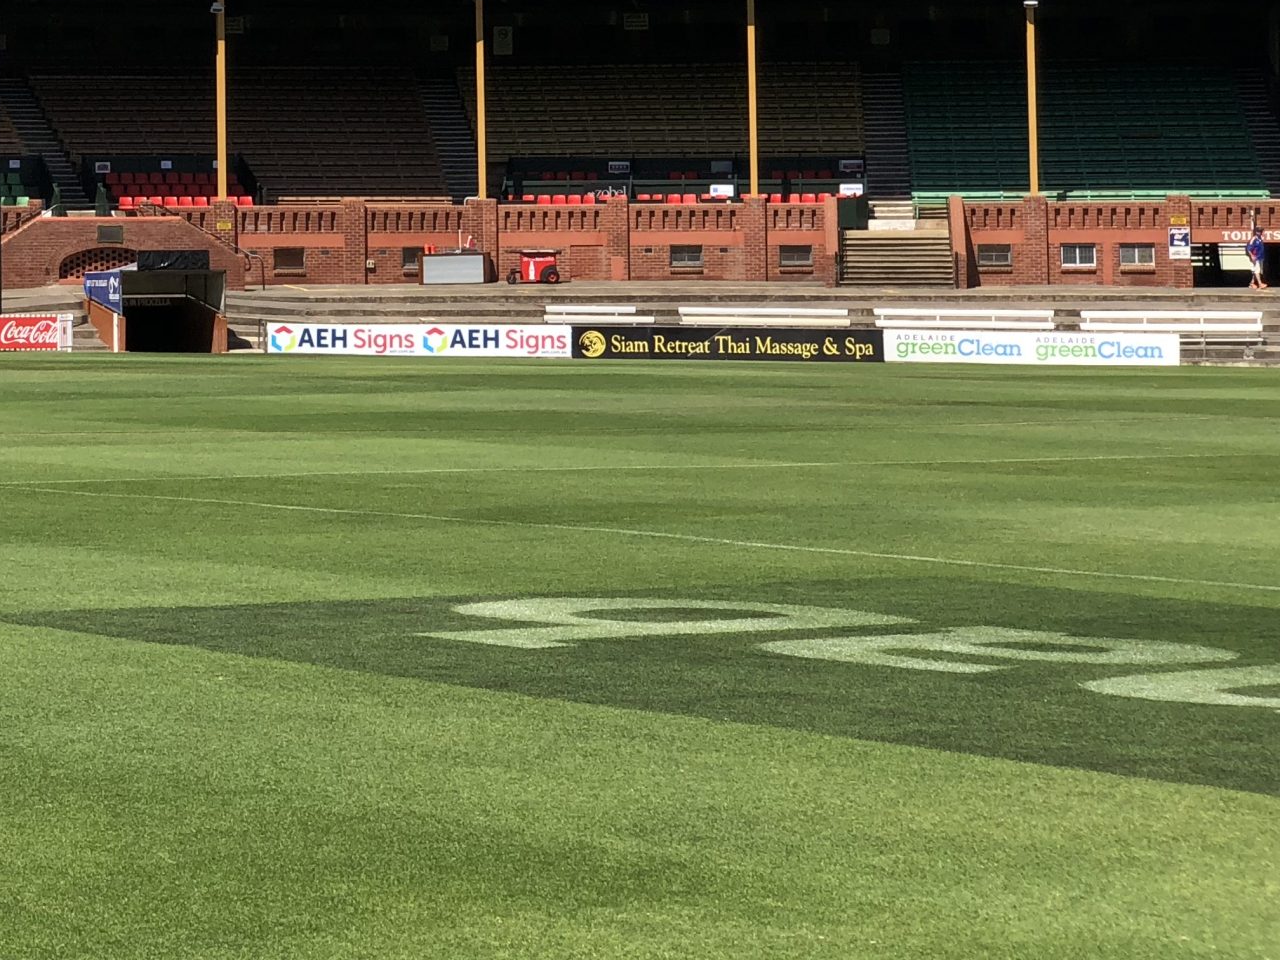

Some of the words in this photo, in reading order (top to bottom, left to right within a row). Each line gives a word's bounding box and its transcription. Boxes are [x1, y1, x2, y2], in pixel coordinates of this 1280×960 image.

[298, 328, 348, 349] AEH
[353, 328, 415, 354] Signs
[449, 329, 499, 349] AEH
[505, 329, 567, 354] Signs
[611, 334, 649, 353] Siam
[653, 335, 710, 354] Retreat
[714, 335, 750, 354] Thai
[755, 336, 819, 359] Massage
[823, 337, 840, 355] &
[845, 337, 874, 359] Spa
[896, 339, 1022, 358] greenClean
[1035, 341, 1163, 361] greenClean
